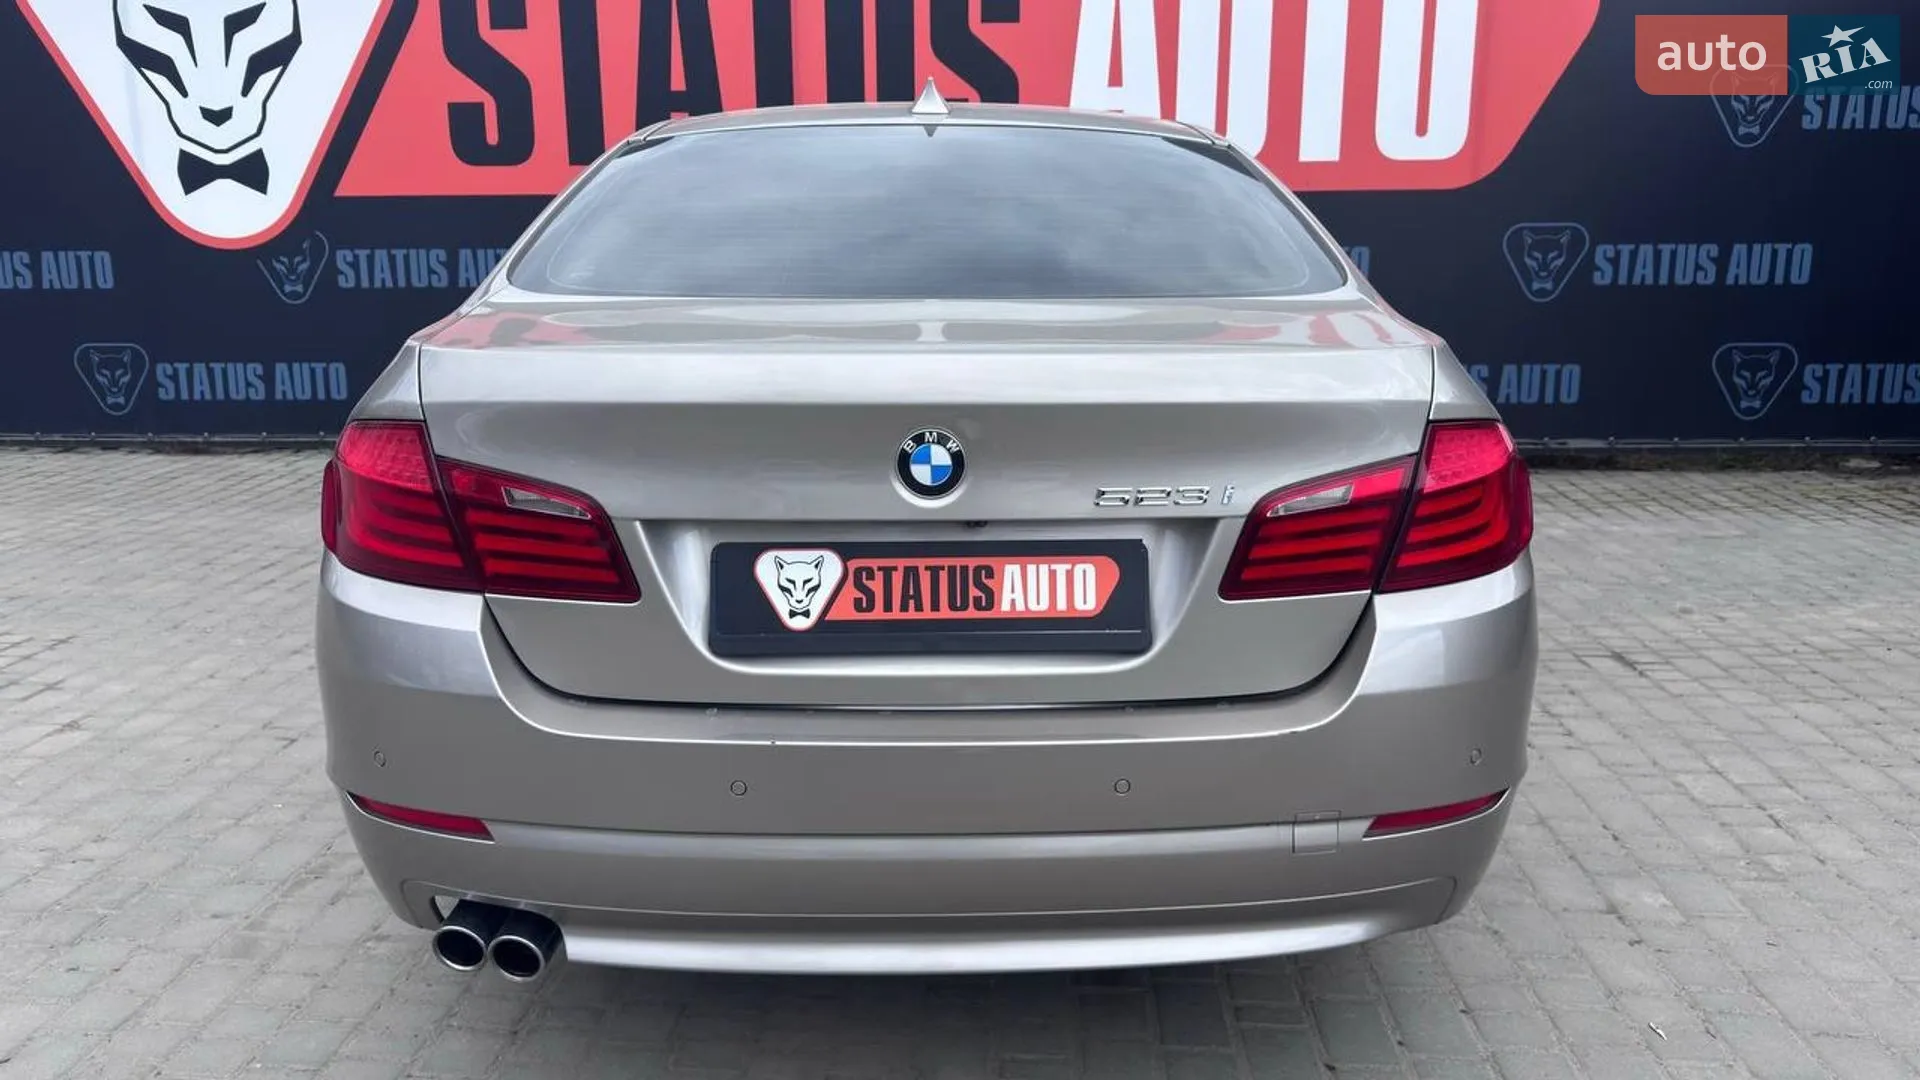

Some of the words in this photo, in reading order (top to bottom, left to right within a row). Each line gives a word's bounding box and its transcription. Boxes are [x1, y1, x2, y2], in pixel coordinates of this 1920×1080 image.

[41, 250, 114, 289] AUTO
[336, 249, 449, 288] STATUS
[458, 248, 511, 287] AU
[1593, 243, 1719, 285] STATUS
[1725, 243, 1813, 285] AUTO
[155, 362, 265, 401] STATUS
[275, 362, 348, 401] AUTO
[1496, 363, 1581, 404] AUTO
[903, 431, 960, 453] BMW
[853, 565, 995, 613] STATUS
[1001, 563, 1096, 612] AUTO
